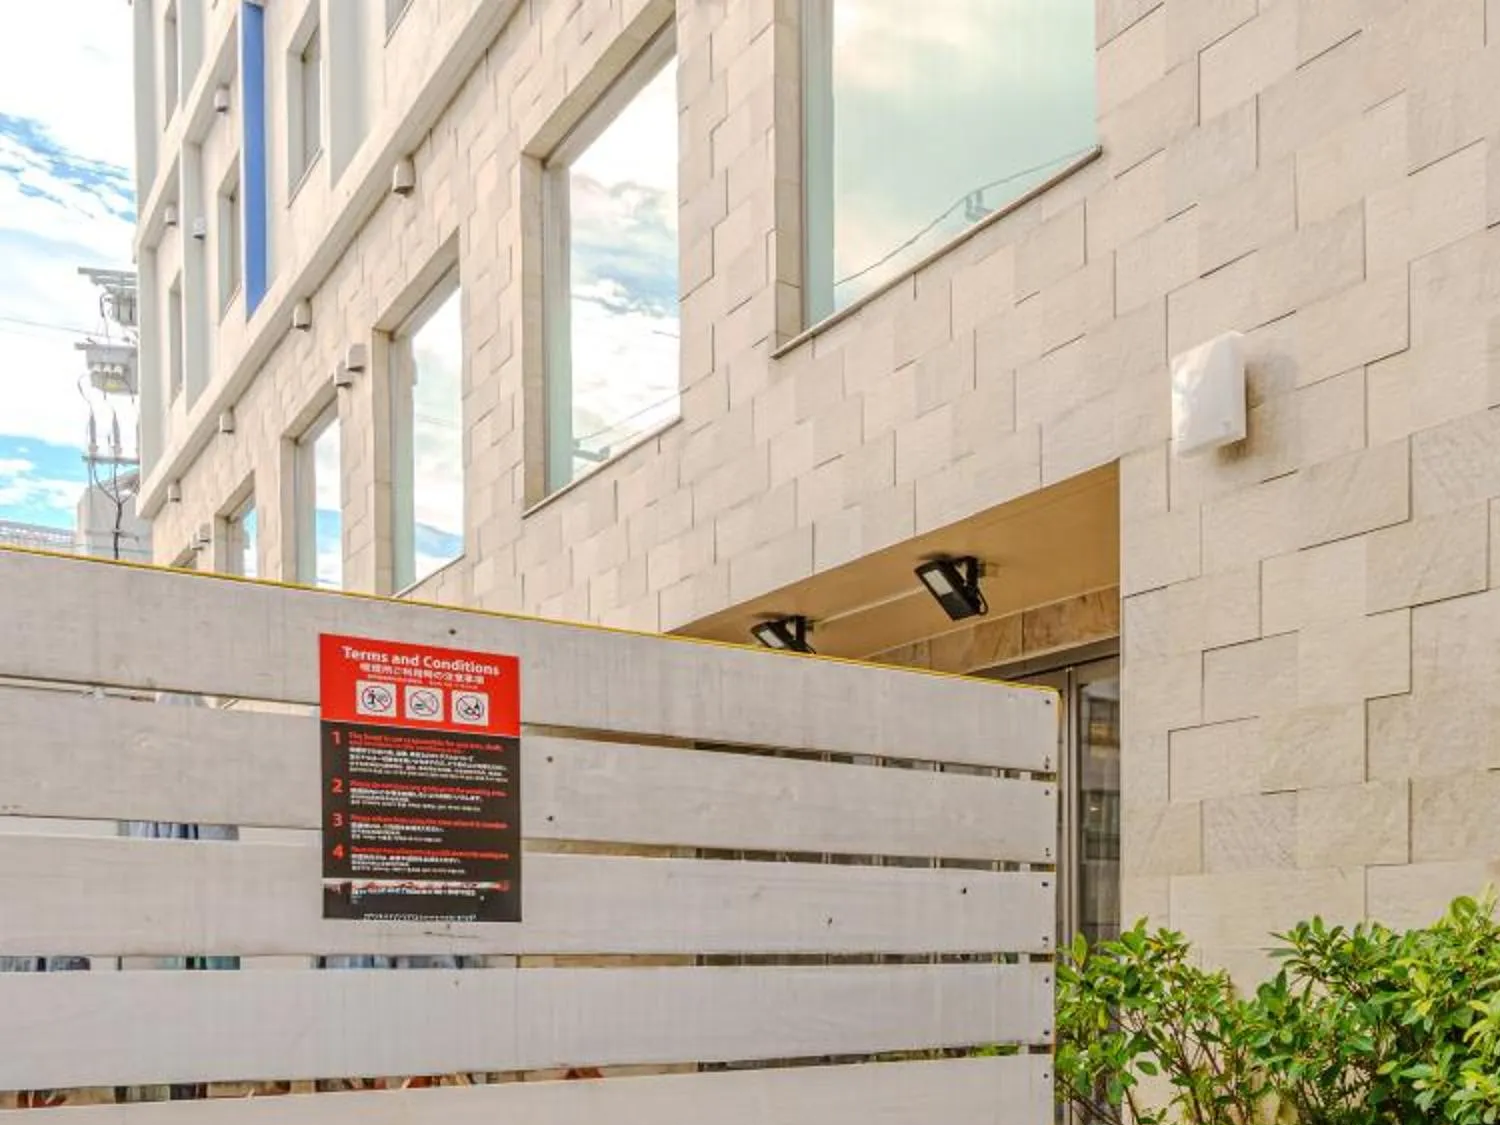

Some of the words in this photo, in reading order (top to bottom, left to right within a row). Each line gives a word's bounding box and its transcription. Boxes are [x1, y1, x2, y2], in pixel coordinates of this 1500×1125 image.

[343, 646, 388, 662] Terms
[392, 655, 420, 667] and
[423, 656, 500, 677] Conditions
[331, 731, 341, 746] 1
[331, 779, 343, 793] 2
[332, 813, 343, 828] 3
[332, 845, 344, 860] 4
